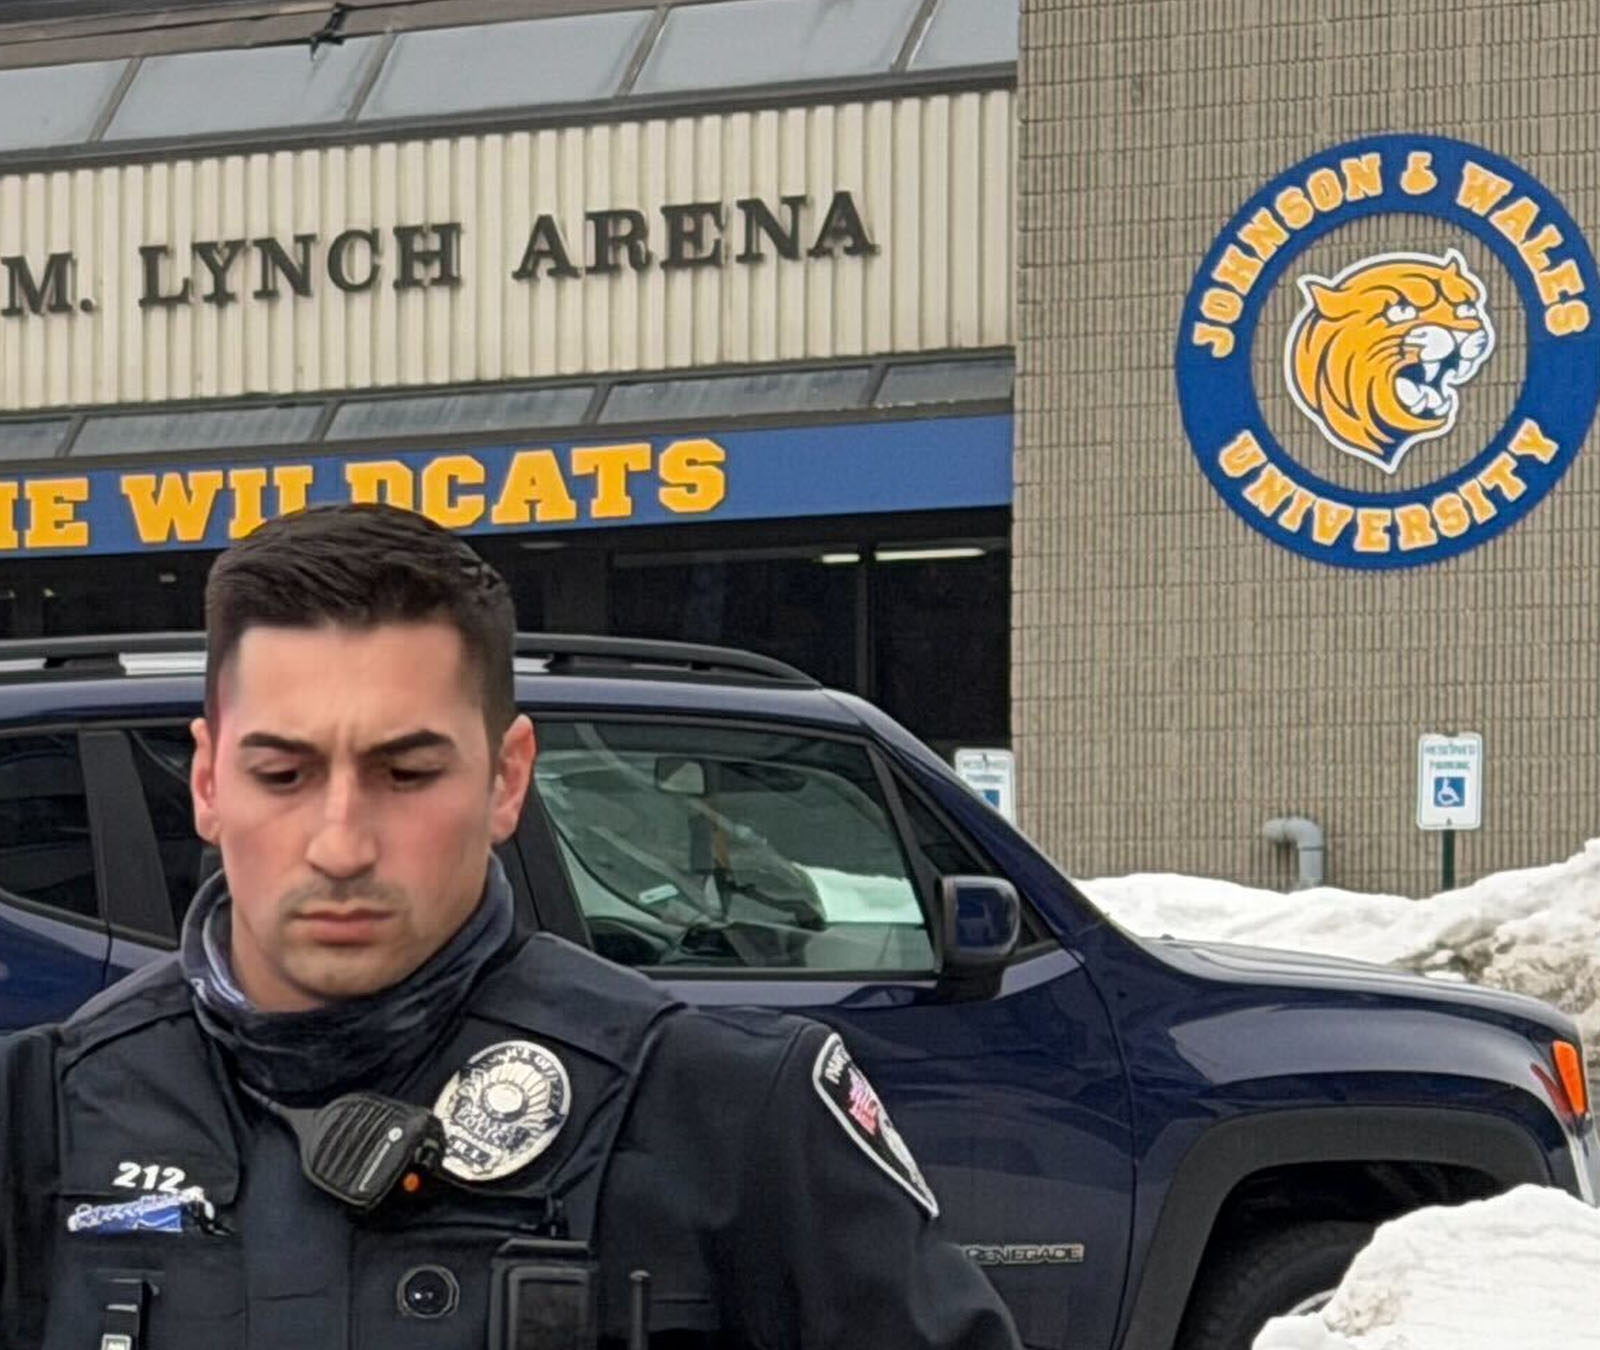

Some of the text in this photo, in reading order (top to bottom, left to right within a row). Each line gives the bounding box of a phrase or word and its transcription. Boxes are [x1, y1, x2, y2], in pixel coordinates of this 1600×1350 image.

[0, 252, 97, 317] M.
[138, 222, 463, 308] LYNCH
[512, 190, 880, 281] ARENA
[1193, 151, 1590, 359] JOHNSON & WALES
[1218, 418, 1559, 553] UNIVERSITY
[112, 1161, 187, 1195] 212
